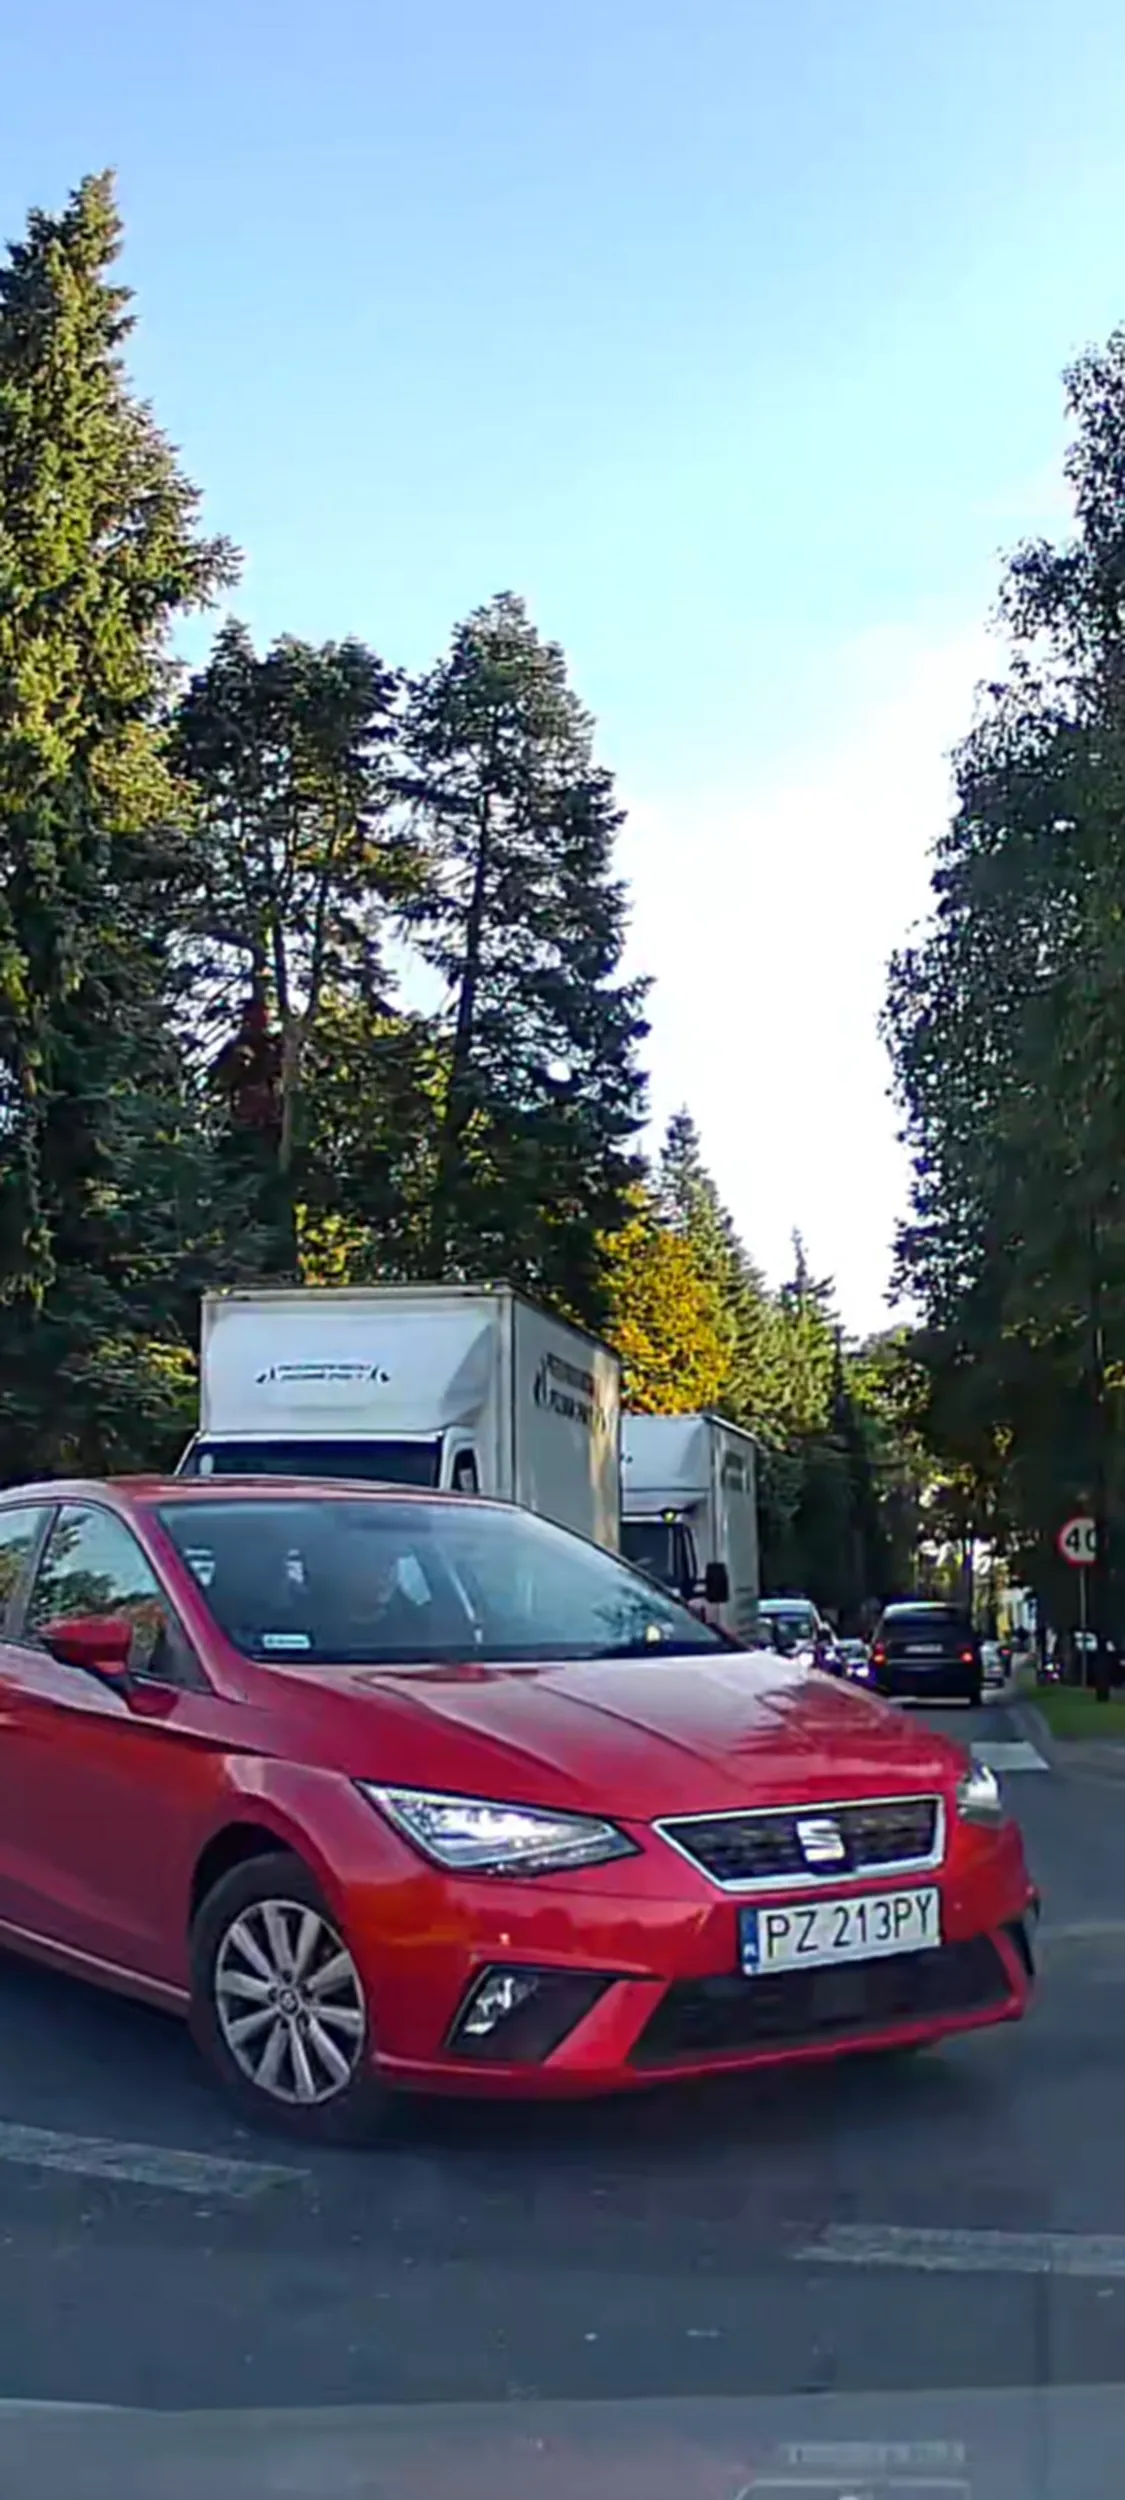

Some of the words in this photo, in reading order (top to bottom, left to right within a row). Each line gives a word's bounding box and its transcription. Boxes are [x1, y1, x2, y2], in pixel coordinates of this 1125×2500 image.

[1065, 1527, 1097, 1553] 40
[766, 1910, 819, 1959] PZ
[832, 1893, 932, 1949] 213PY
